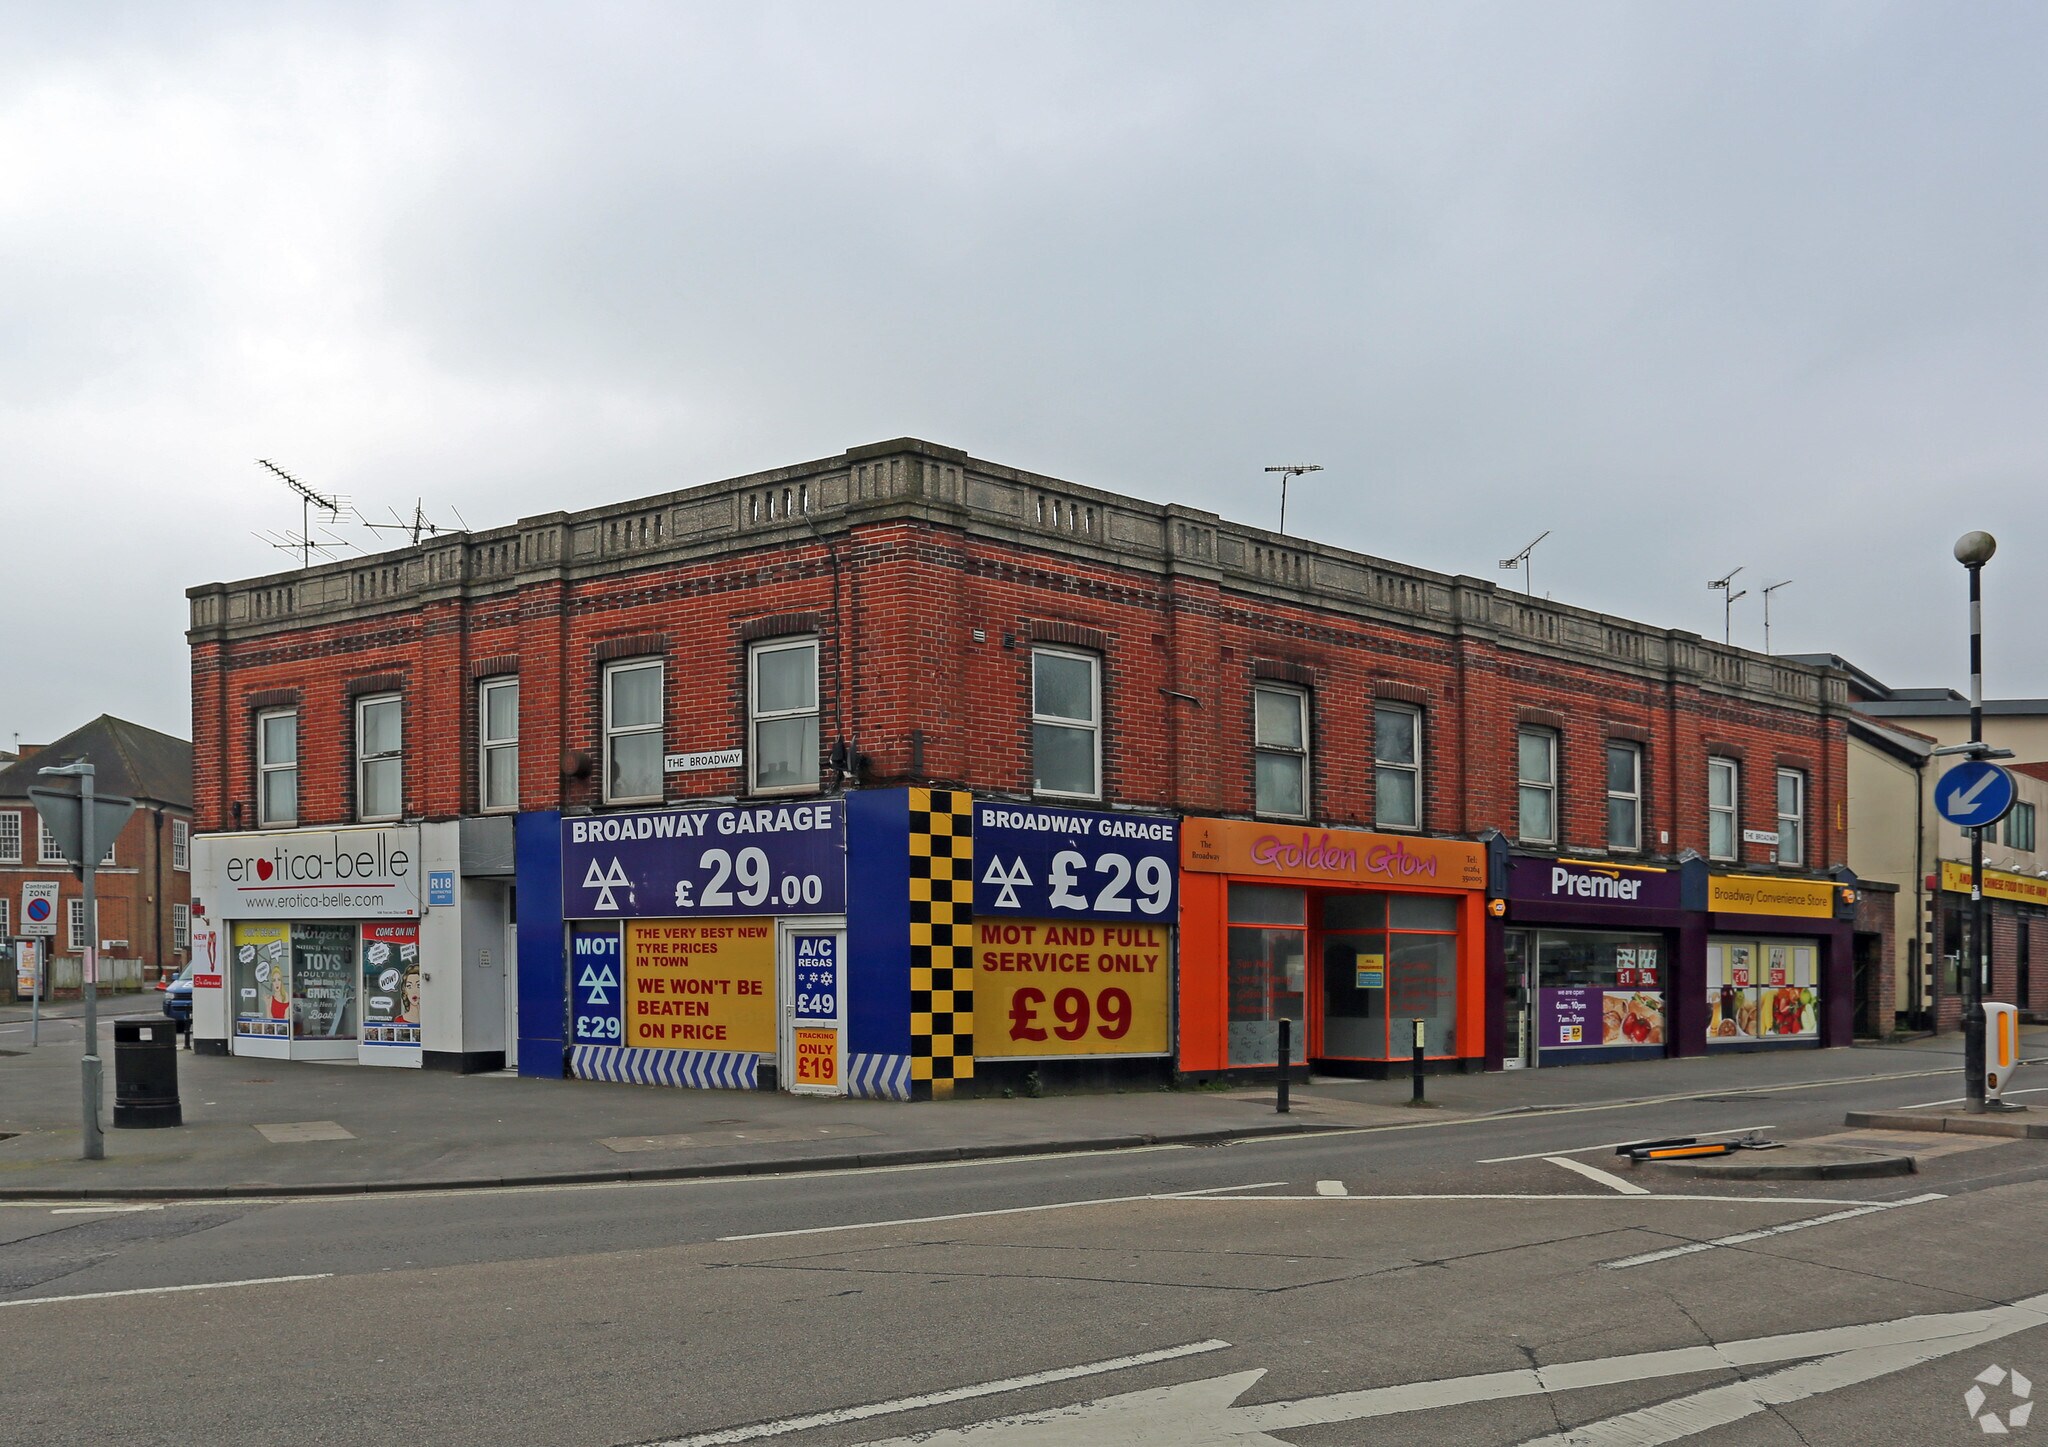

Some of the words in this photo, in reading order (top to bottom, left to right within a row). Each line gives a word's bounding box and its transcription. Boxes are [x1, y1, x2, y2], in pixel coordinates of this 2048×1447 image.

[668, 758, 684, 768] THE
[690, 754, 740, 766] BROADWAY
[573, 814, 709, 843] BROADWAY
[718, 806, 832, 835] GARAGE
[982, 810, 1093, 834] BROADWAY
[1099, 820, 1173, 841] GARAGE
[1204, 830, 1208, 838] 4
[1755, 834, 1777, 842] BROADWAY
[1192, 852, 1219, 862] Broadway
[1251, 832, 1356, 872] Golden
[1365, 841, 1437, 878] Glow
[1464, 866, 1480, 874] 01264
[431, 878, 451, 888] R18
[1049, 851, 1172, 914] £29
[1552, 867, 1641, 900] Premier
[246, 893, 383, 909] www.erotica-belle.com
[1715, 887, 1754, 904] Broadway
[1757, 890, 1805, 905] Convenience
[1808, 894, 1828, 906] Store
[376, 928, 393, 936] COME
[395, 928, 404, 936] ON
[406, 927, 416, 936] IN!
[636, 928, 659, 939] THE
[664, 928, 695, 938] VERY
[701, 928, 733, 938] BEST
[738, 927, 768, 937] NEW
[982, 925, 1036, 944] MOT
[1044, 927, 1094, 946] AND
[1104, 928, 1160, 947] FULL
[576, 938, 618, 955] MOT
[636, 944, 668, 953] TYRE
[672, 943, 717, 953] PRICES
[799, 939, 832, 956] A/C
[304, 954, 341, 970] TOYS
[636, 957, 648, 966] IN
[653, 957, 688, 967] TOWN
[799, 959, 832, 967] REGAS
[983, 952, 1089, 972] SERVICE
[1098, 954, 1158, 973] ONLY
[1621, 971, 1629, 983] £1
[308, 989, 340, 998] GAMES
[637, 979, 664, 993] WE
[670, 980, 730, 995] WON'T
[738, 980, 762, 995] BE
[638, 1001, 709, 1016] BEATEN
[798, 994, 834, 1013] £49
[1009, 987, 1132, 1042] £99
[577, 1016, 620, 1038] £29
[640, 1024, 664, 1038] ON
[671, 1025, 726, 1040] PRICE
[799, 1044, 833, 1055] ONLY
[799, 1058, 833, 1078] £19
